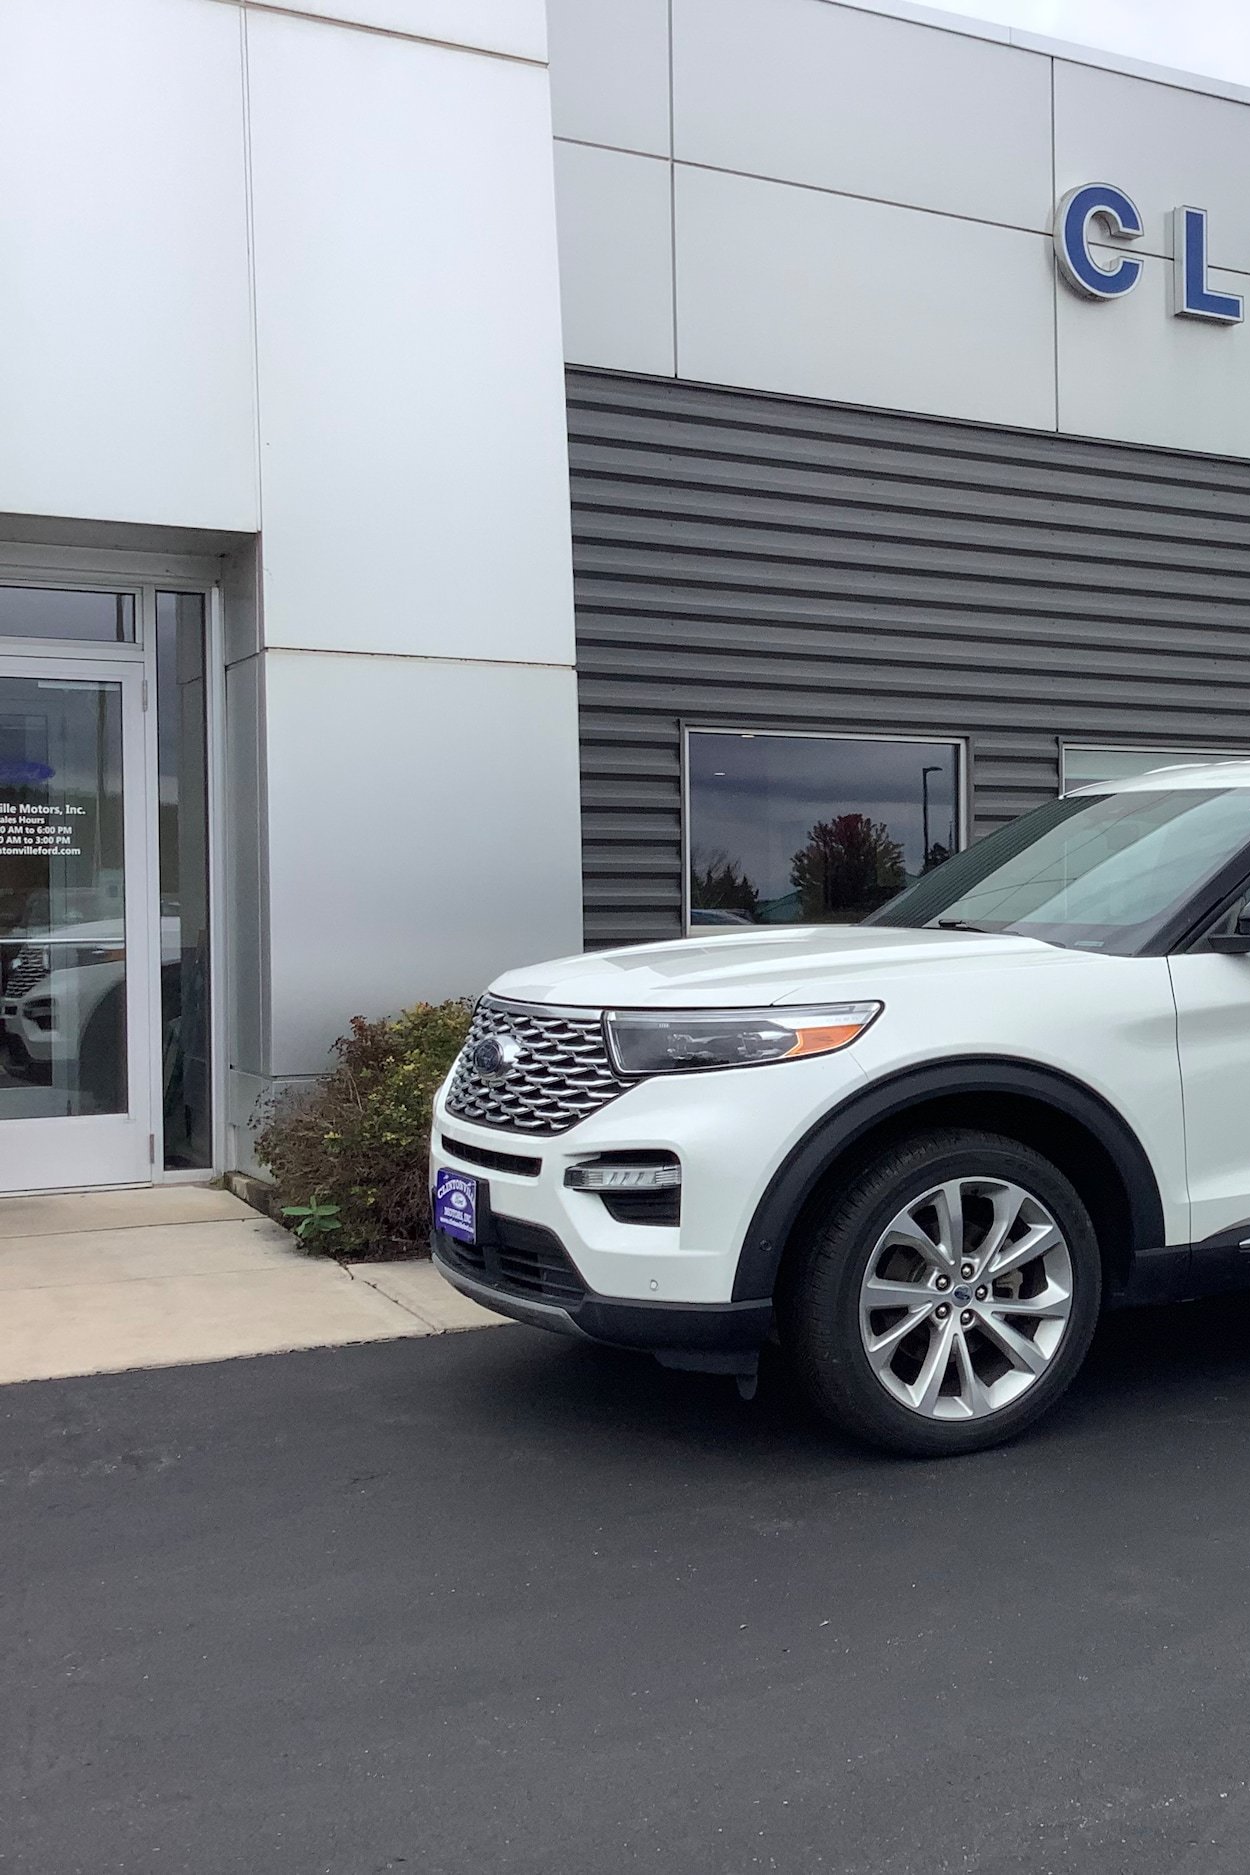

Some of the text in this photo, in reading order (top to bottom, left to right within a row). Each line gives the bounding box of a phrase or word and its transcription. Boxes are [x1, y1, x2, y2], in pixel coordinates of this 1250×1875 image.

[19, 803, 63, 815] Motors,
[65, 804, 86, 815] Inc.
[18, 816, 45, 824] Hours
[7, 826, 23, 834] AM
[25, 826, 35, 834] to
[36, 826, 56, 834] 6:00
[57, 826, 72, 834] PM
[6, 836, 21, 844] AM
[24, 836, 34, 844] to
[35, 836, 55, 844] 3:00
[56, 836, 71, 844] PM
